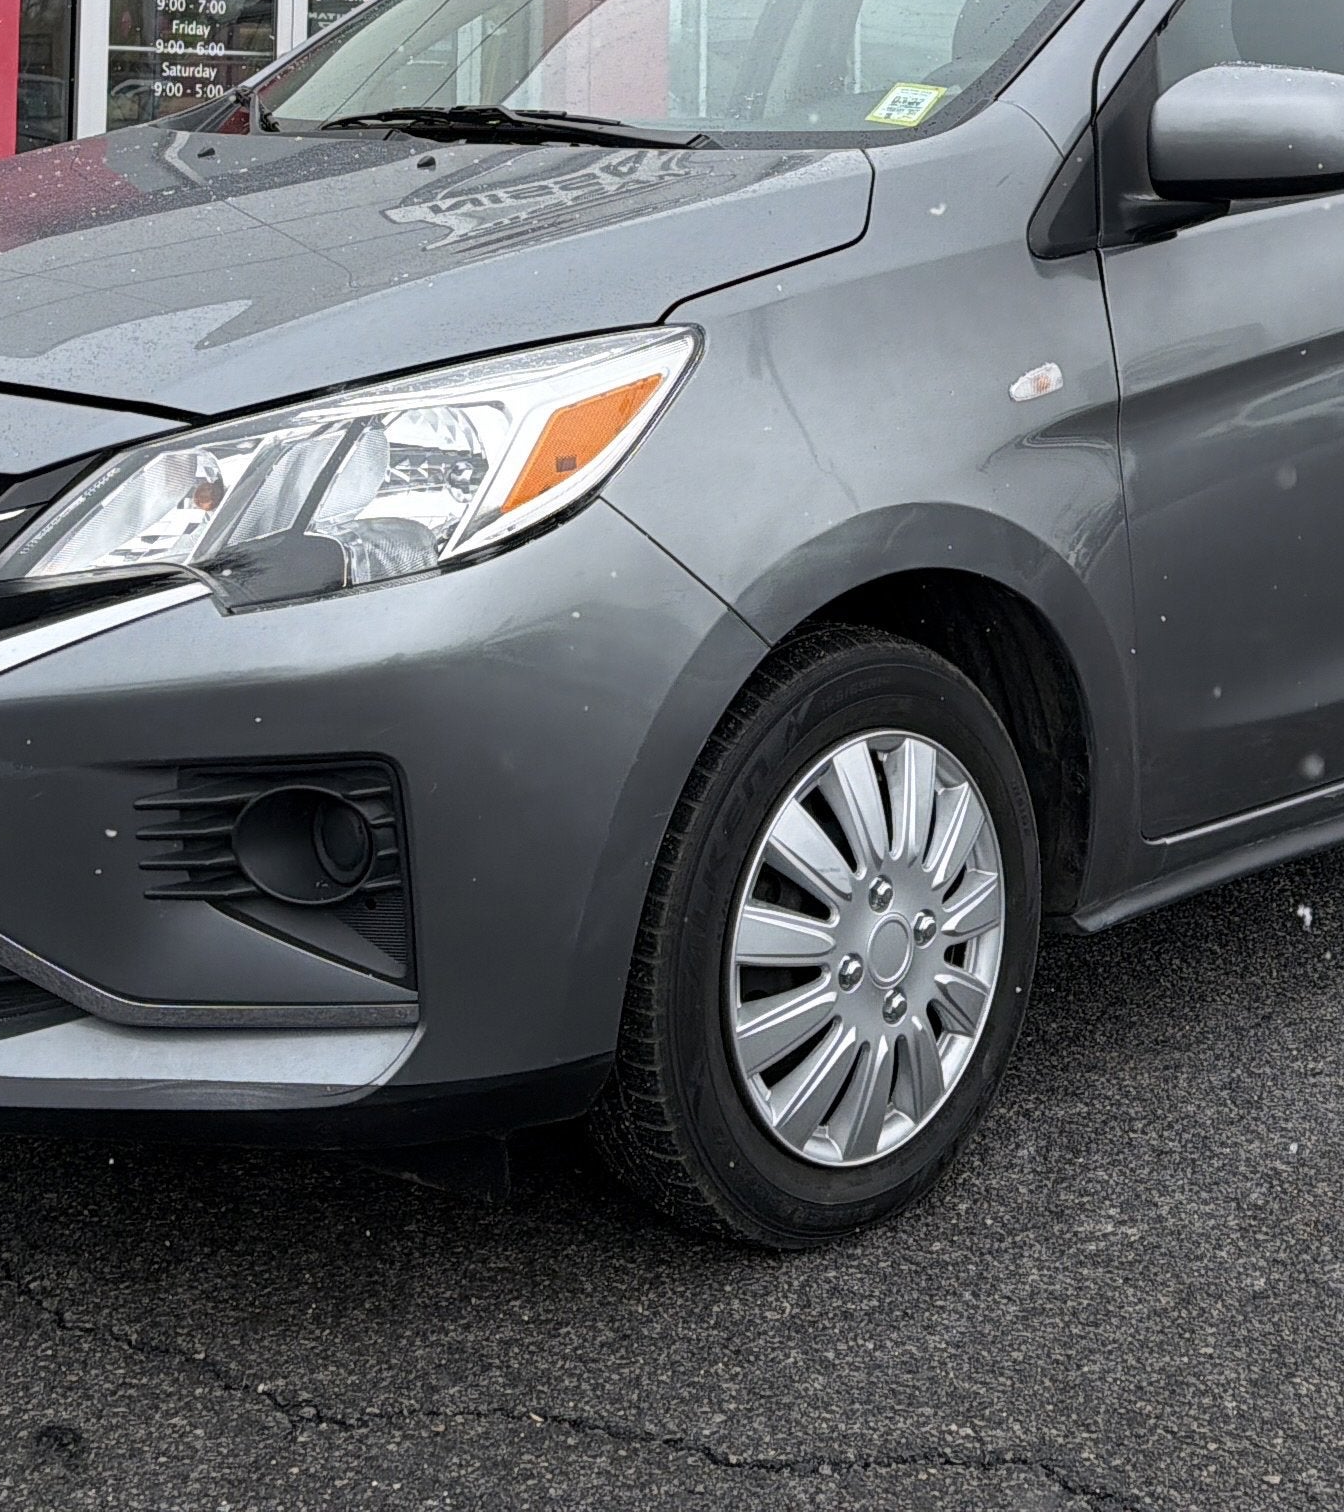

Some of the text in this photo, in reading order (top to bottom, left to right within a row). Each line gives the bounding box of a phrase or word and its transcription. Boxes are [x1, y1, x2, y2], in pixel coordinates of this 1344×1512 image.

[198, 0, 227, 15] 7:00
[171, 20, 211, 39] Friday
[155, 39, 185, 55] 9:00
[196, 42, 225, 57] 6:00
[161, 61, 218, 81] Saturday
[153, 81, 183, 97] 9:00
[195, 83, 224, 98] 5:00
